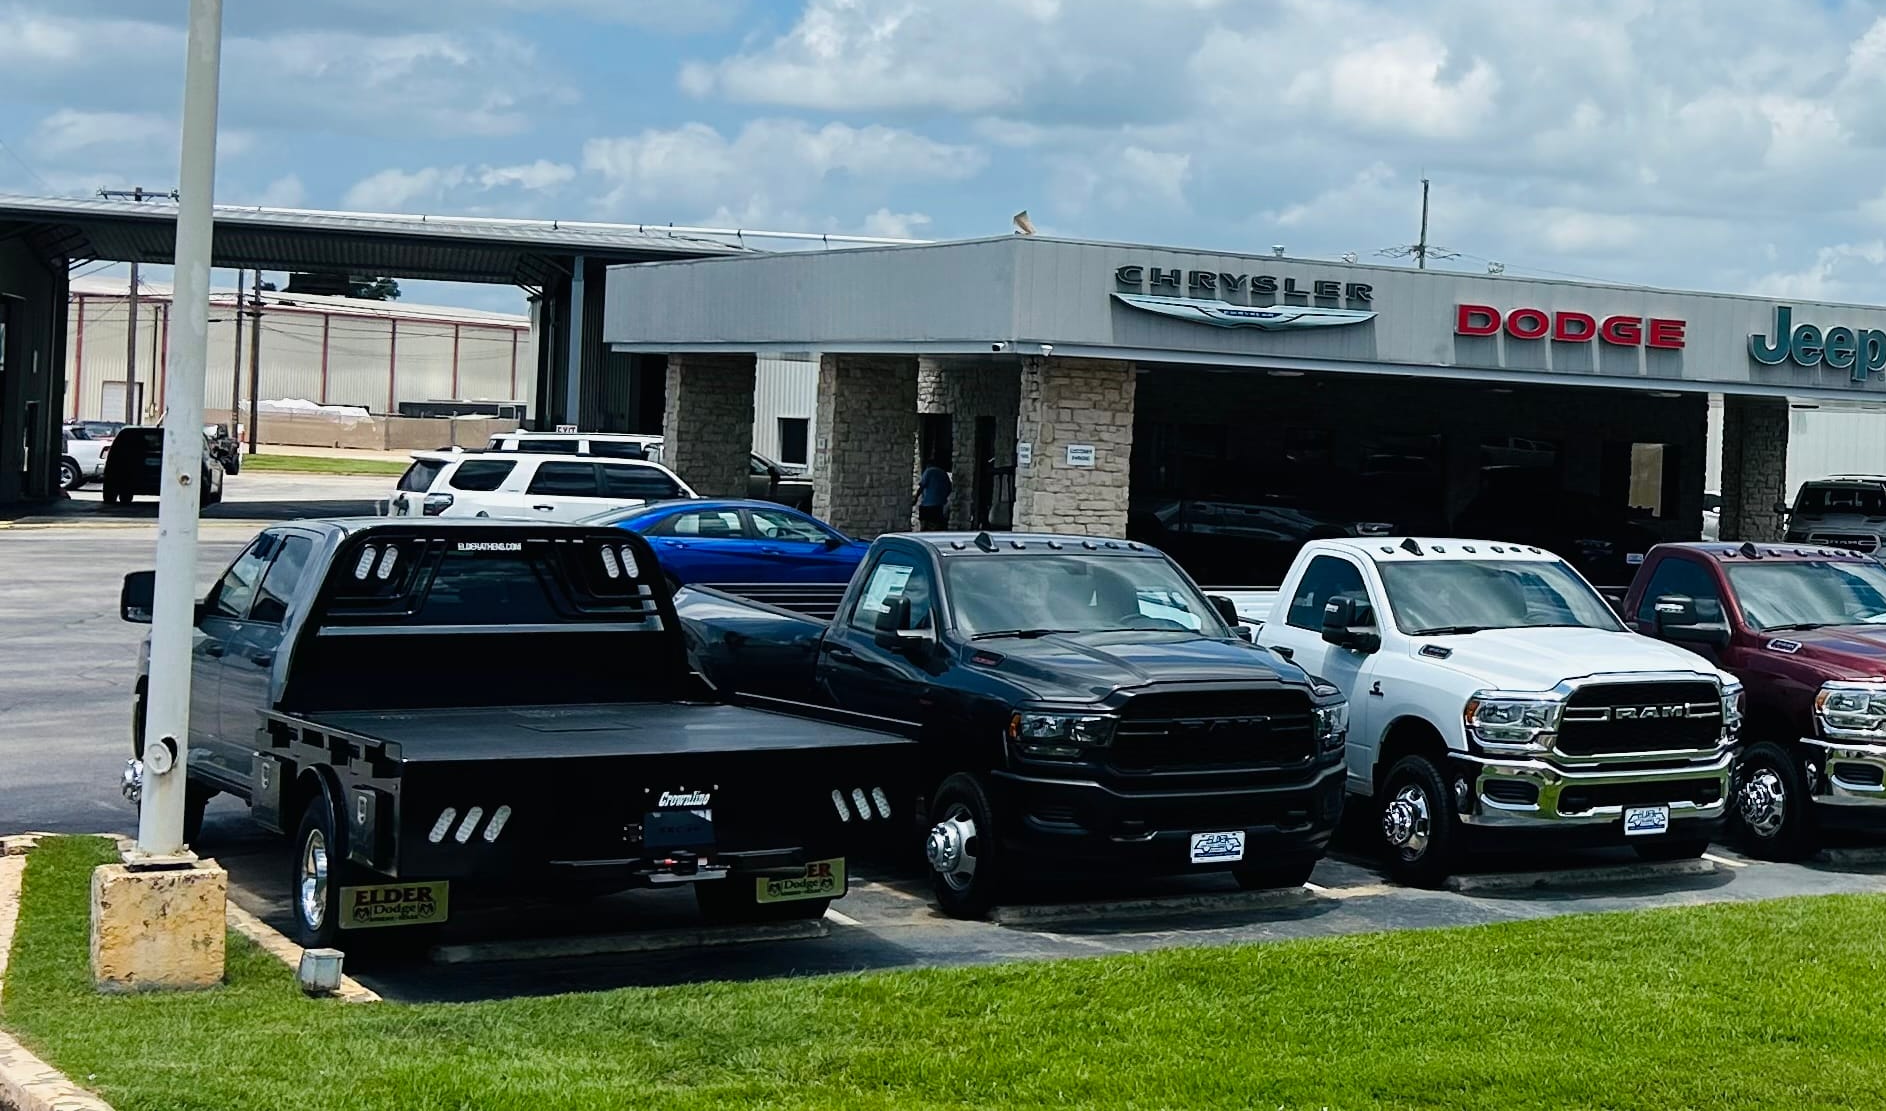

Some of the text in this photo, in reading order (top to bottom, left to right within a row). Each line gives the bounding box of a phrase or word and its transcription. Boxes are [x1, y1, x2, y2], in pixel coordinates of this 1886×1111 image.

[1115, 265, 1374, 301] CHRYSLER
[1454, 304, 1687, 349] DODGE
[1616, 705, 1683, 720] RAM
[783, 878, 820, 891] Dodge
[355, 886, 433, 905] ELDER
[373, 902, 417, 917] Dodge
